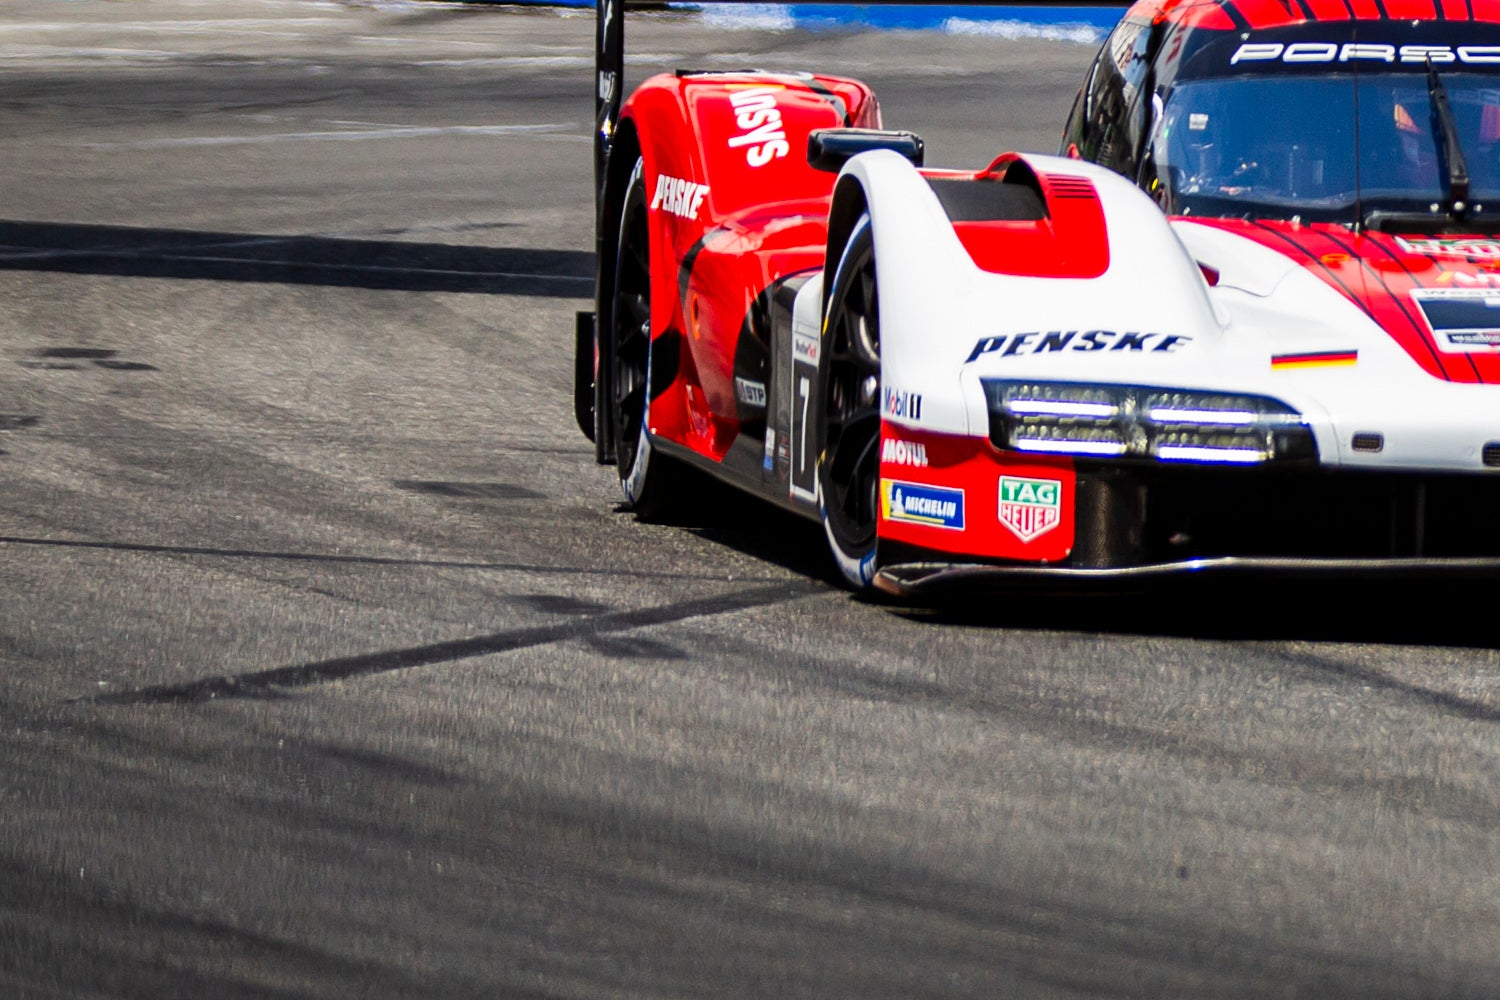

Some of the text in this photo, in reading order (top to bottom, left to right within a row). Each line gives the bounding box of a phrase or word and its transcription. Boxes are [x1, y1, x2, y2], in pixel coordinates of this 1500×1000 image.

[650, 173, 711, 222] PENSKE
[964, 329, 1195, 365] PENSKE
[883, 386, 907, 418] Mobil
[882, 438, 928, 468] MOTUL
[904, 495, 957, 519] MICHELIN
[1004, 480, 1057, 506] TAG
[1001, 504, 1057, 536] HEUER
